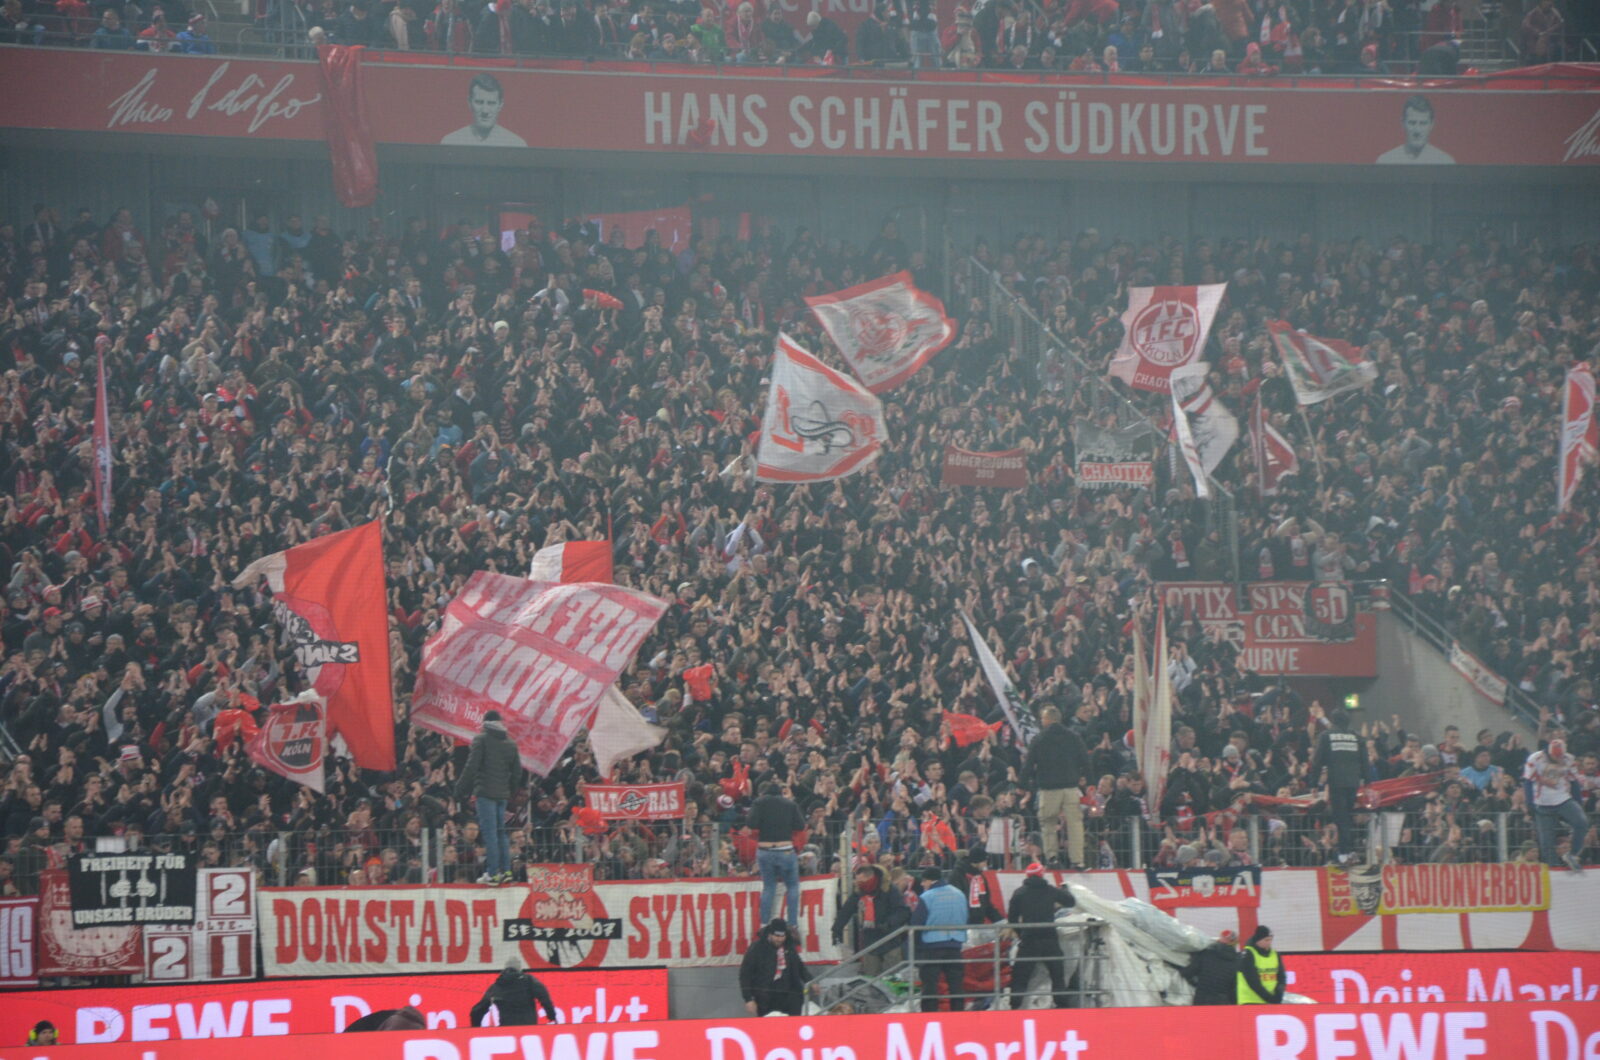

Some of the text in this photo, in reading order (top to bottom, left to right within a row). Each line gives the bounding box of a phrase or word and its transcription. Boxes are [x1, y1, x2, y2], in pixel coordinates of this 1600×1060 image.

[644, 87, 1269, 156] HANS SCHÄFER SÜDKURVE
[1082, 463, 1151, 481] CHAOTIX
[281, 721, 321, 740] 1.FC
[81, 852, 186, 872] FREIHEIT FÜR
[212, 873, 246, 915] 2
[1381, 863, 1544, 909] STADIONVERBOT
[74, 904, 193, 924] UNSERE BRÜDER
[274, 888, 825, 964] DOMSTADT SYNDIT
[152, 937, 187, 979] 2
[221, 935, 240, 976] 1
[1256, 1011, 1488, 1060] REWE
